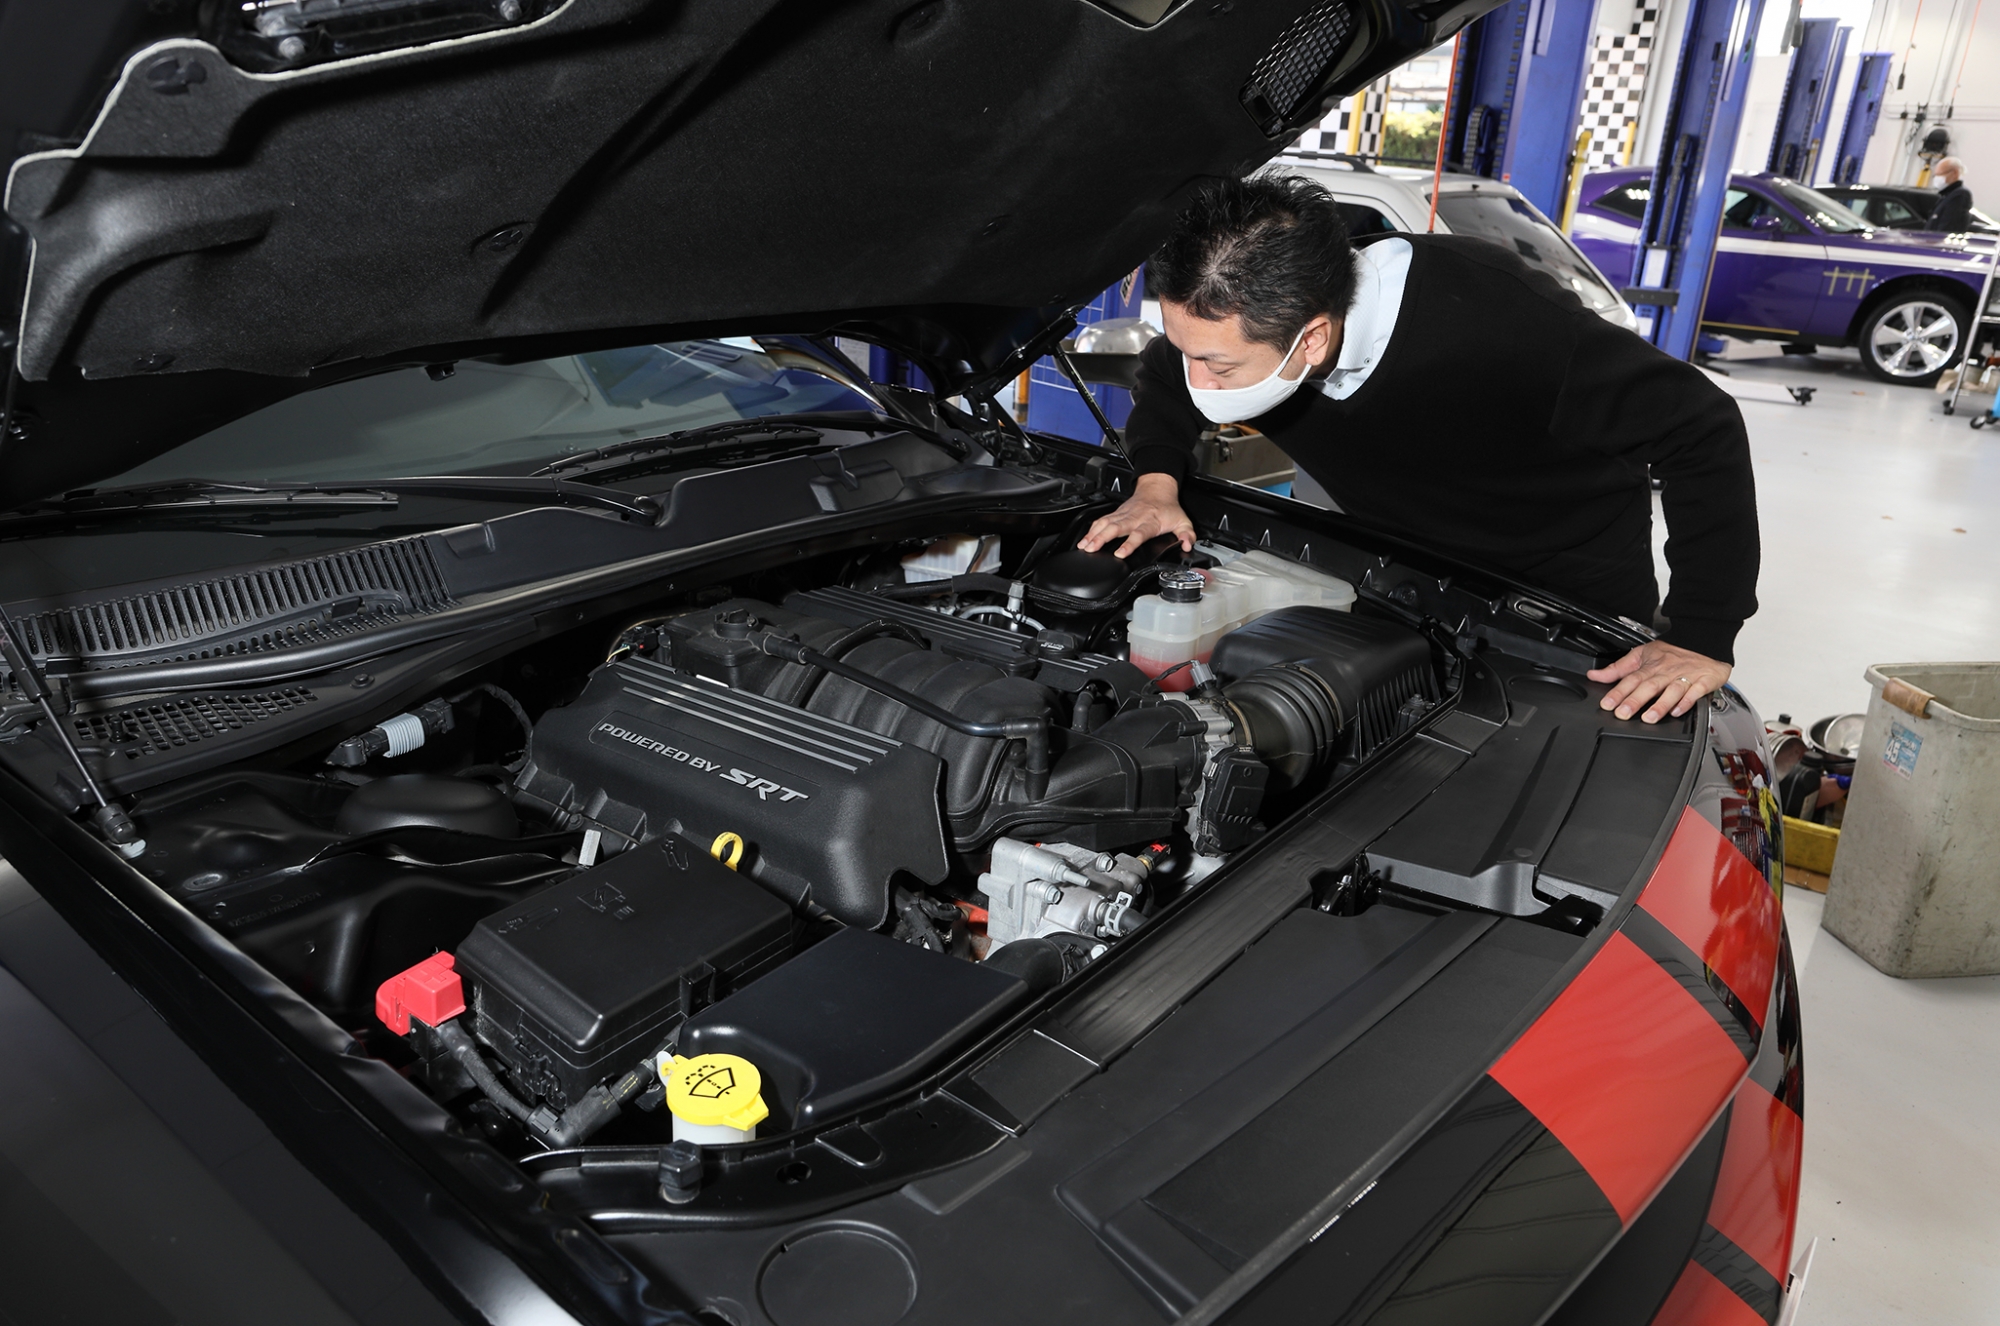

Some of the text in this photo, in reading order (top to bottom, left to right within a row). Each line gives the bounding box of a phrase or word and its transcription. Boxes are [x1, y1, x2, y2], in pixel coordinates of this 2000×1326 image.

[598, 723, 809, 801] POWERED BY SRT
[1885, 739, 1900, 764] 45
